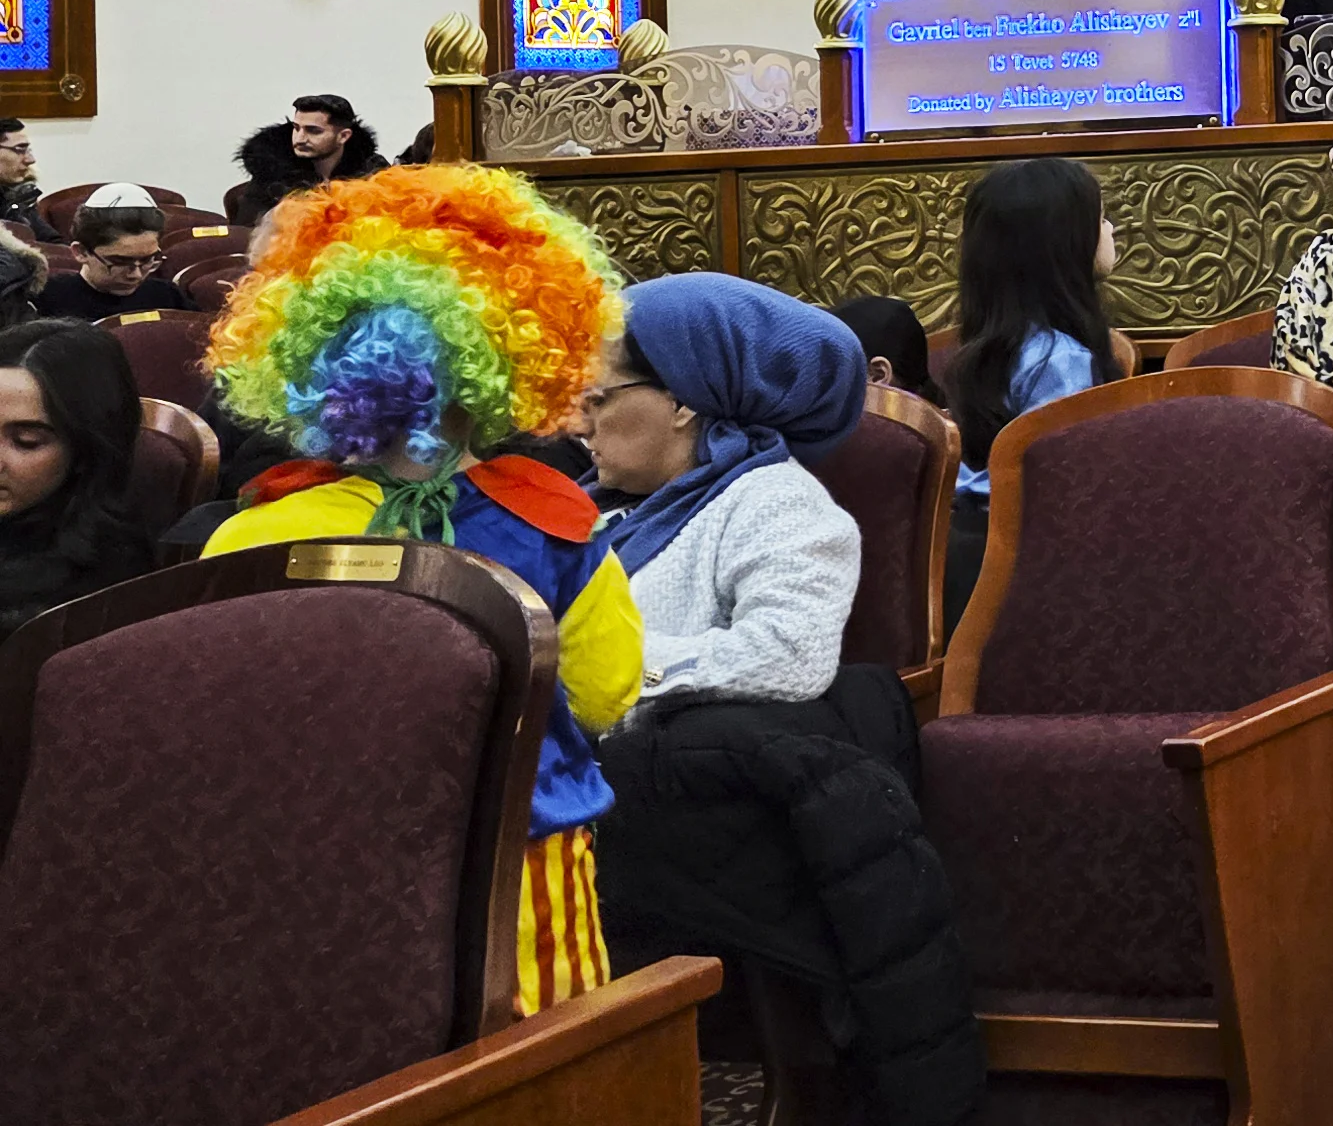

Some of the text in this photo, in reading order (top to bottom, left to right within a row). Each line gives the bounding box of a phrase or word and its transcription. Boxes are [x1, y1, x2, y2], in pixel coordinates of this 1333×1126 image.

[888, 9, 1201, 43] Gavriel ben Frekho Alishayev z"l
[988, 50, 1099, 73] 15 Tevet 5748
[907, 80, 1185, 114] Donated by Alishayev brothers
